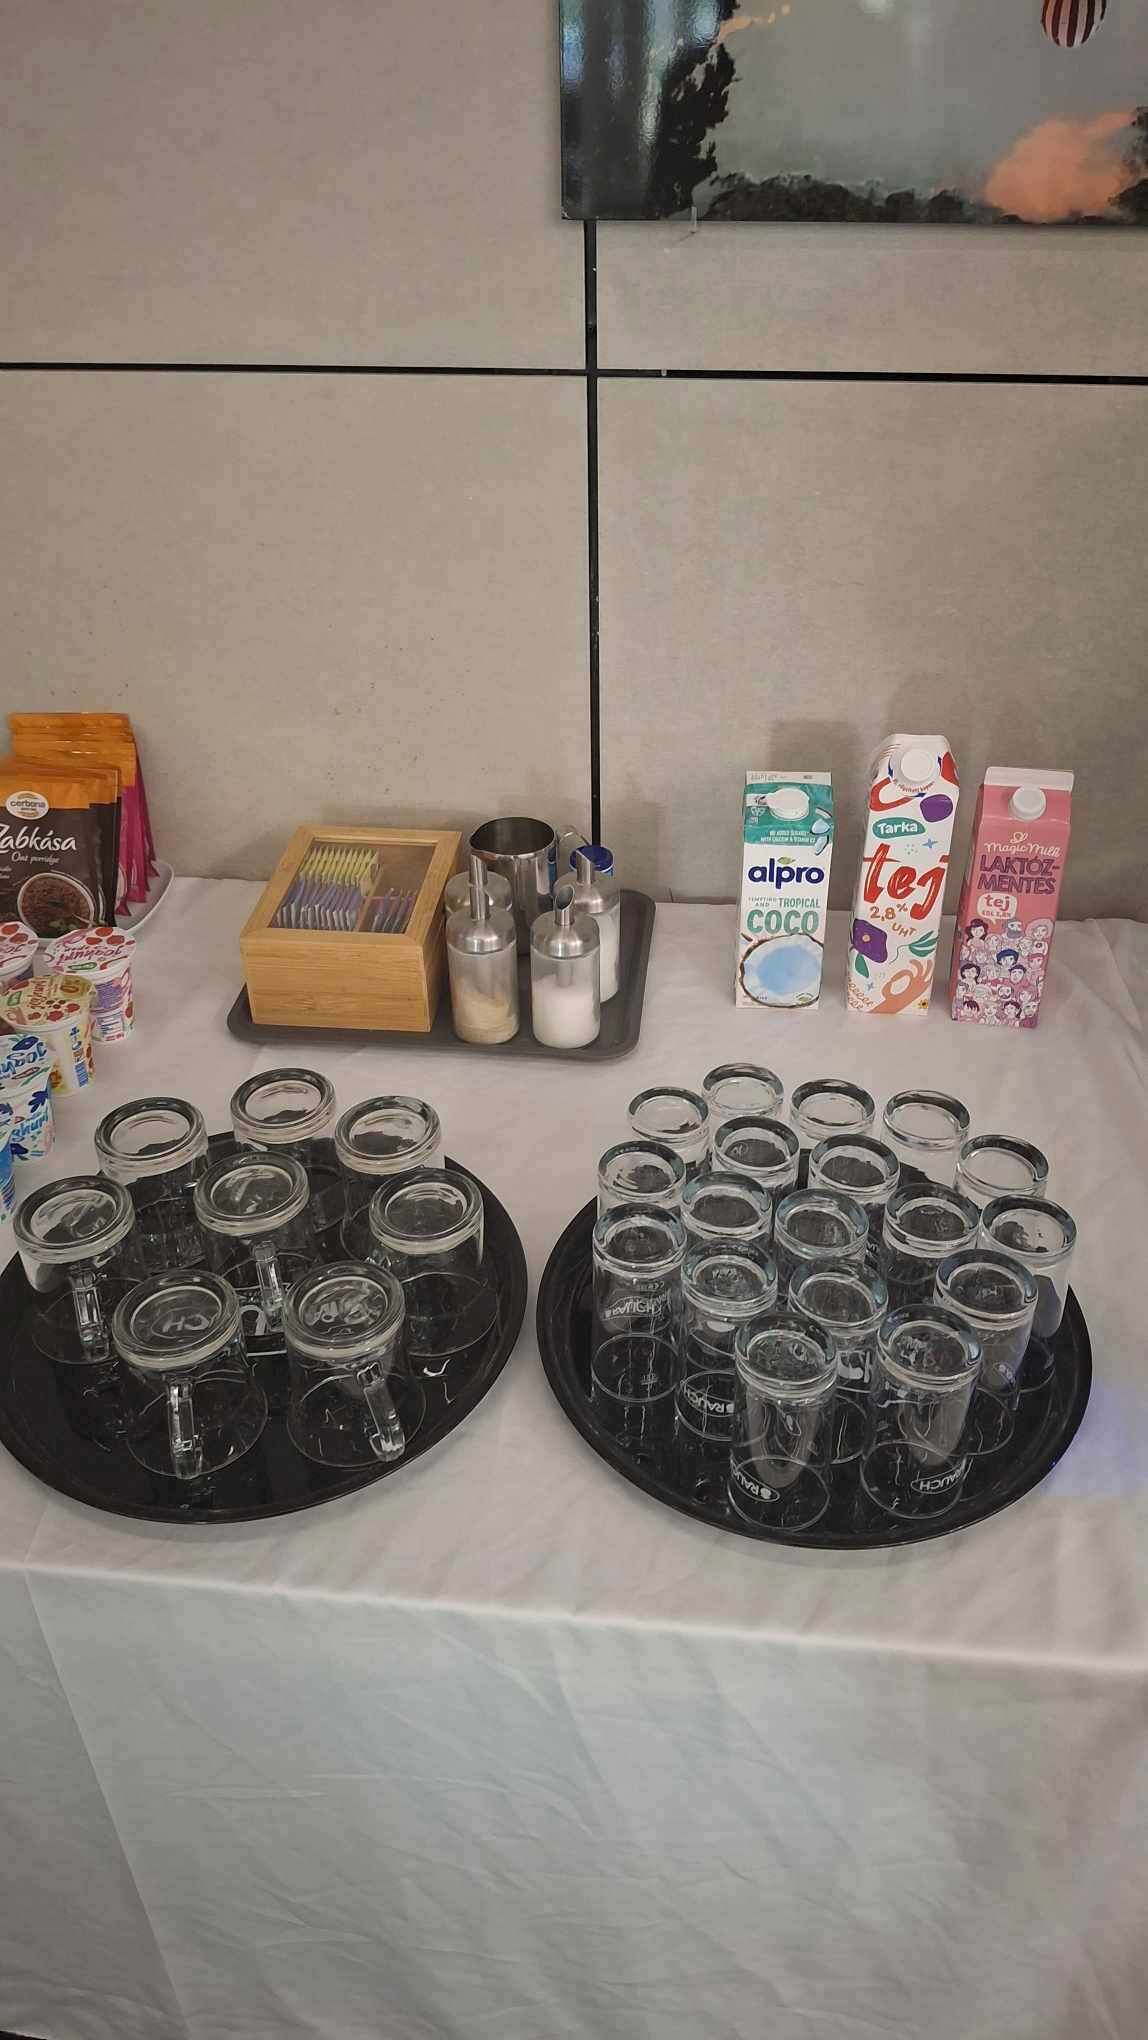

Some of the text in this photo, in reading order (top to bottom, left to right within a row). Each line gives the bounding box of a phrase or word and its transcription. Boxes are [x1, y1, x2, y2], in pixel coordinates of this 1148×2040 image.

[877, 821, 918, 834] Tarka
[748, 858, 825, 889] alpro
[979, 855, 1061, 876] LAKTÓZ-
[863, 843, 949, 920] tej
[977, 873, 1057, 895] MENTES
[778, 898, 821, 909] TROPICAL
[984, 895, 1011, 911] tej
[747, 909, 819, 934] COCO
[891, 923, 917, 937] UHT
